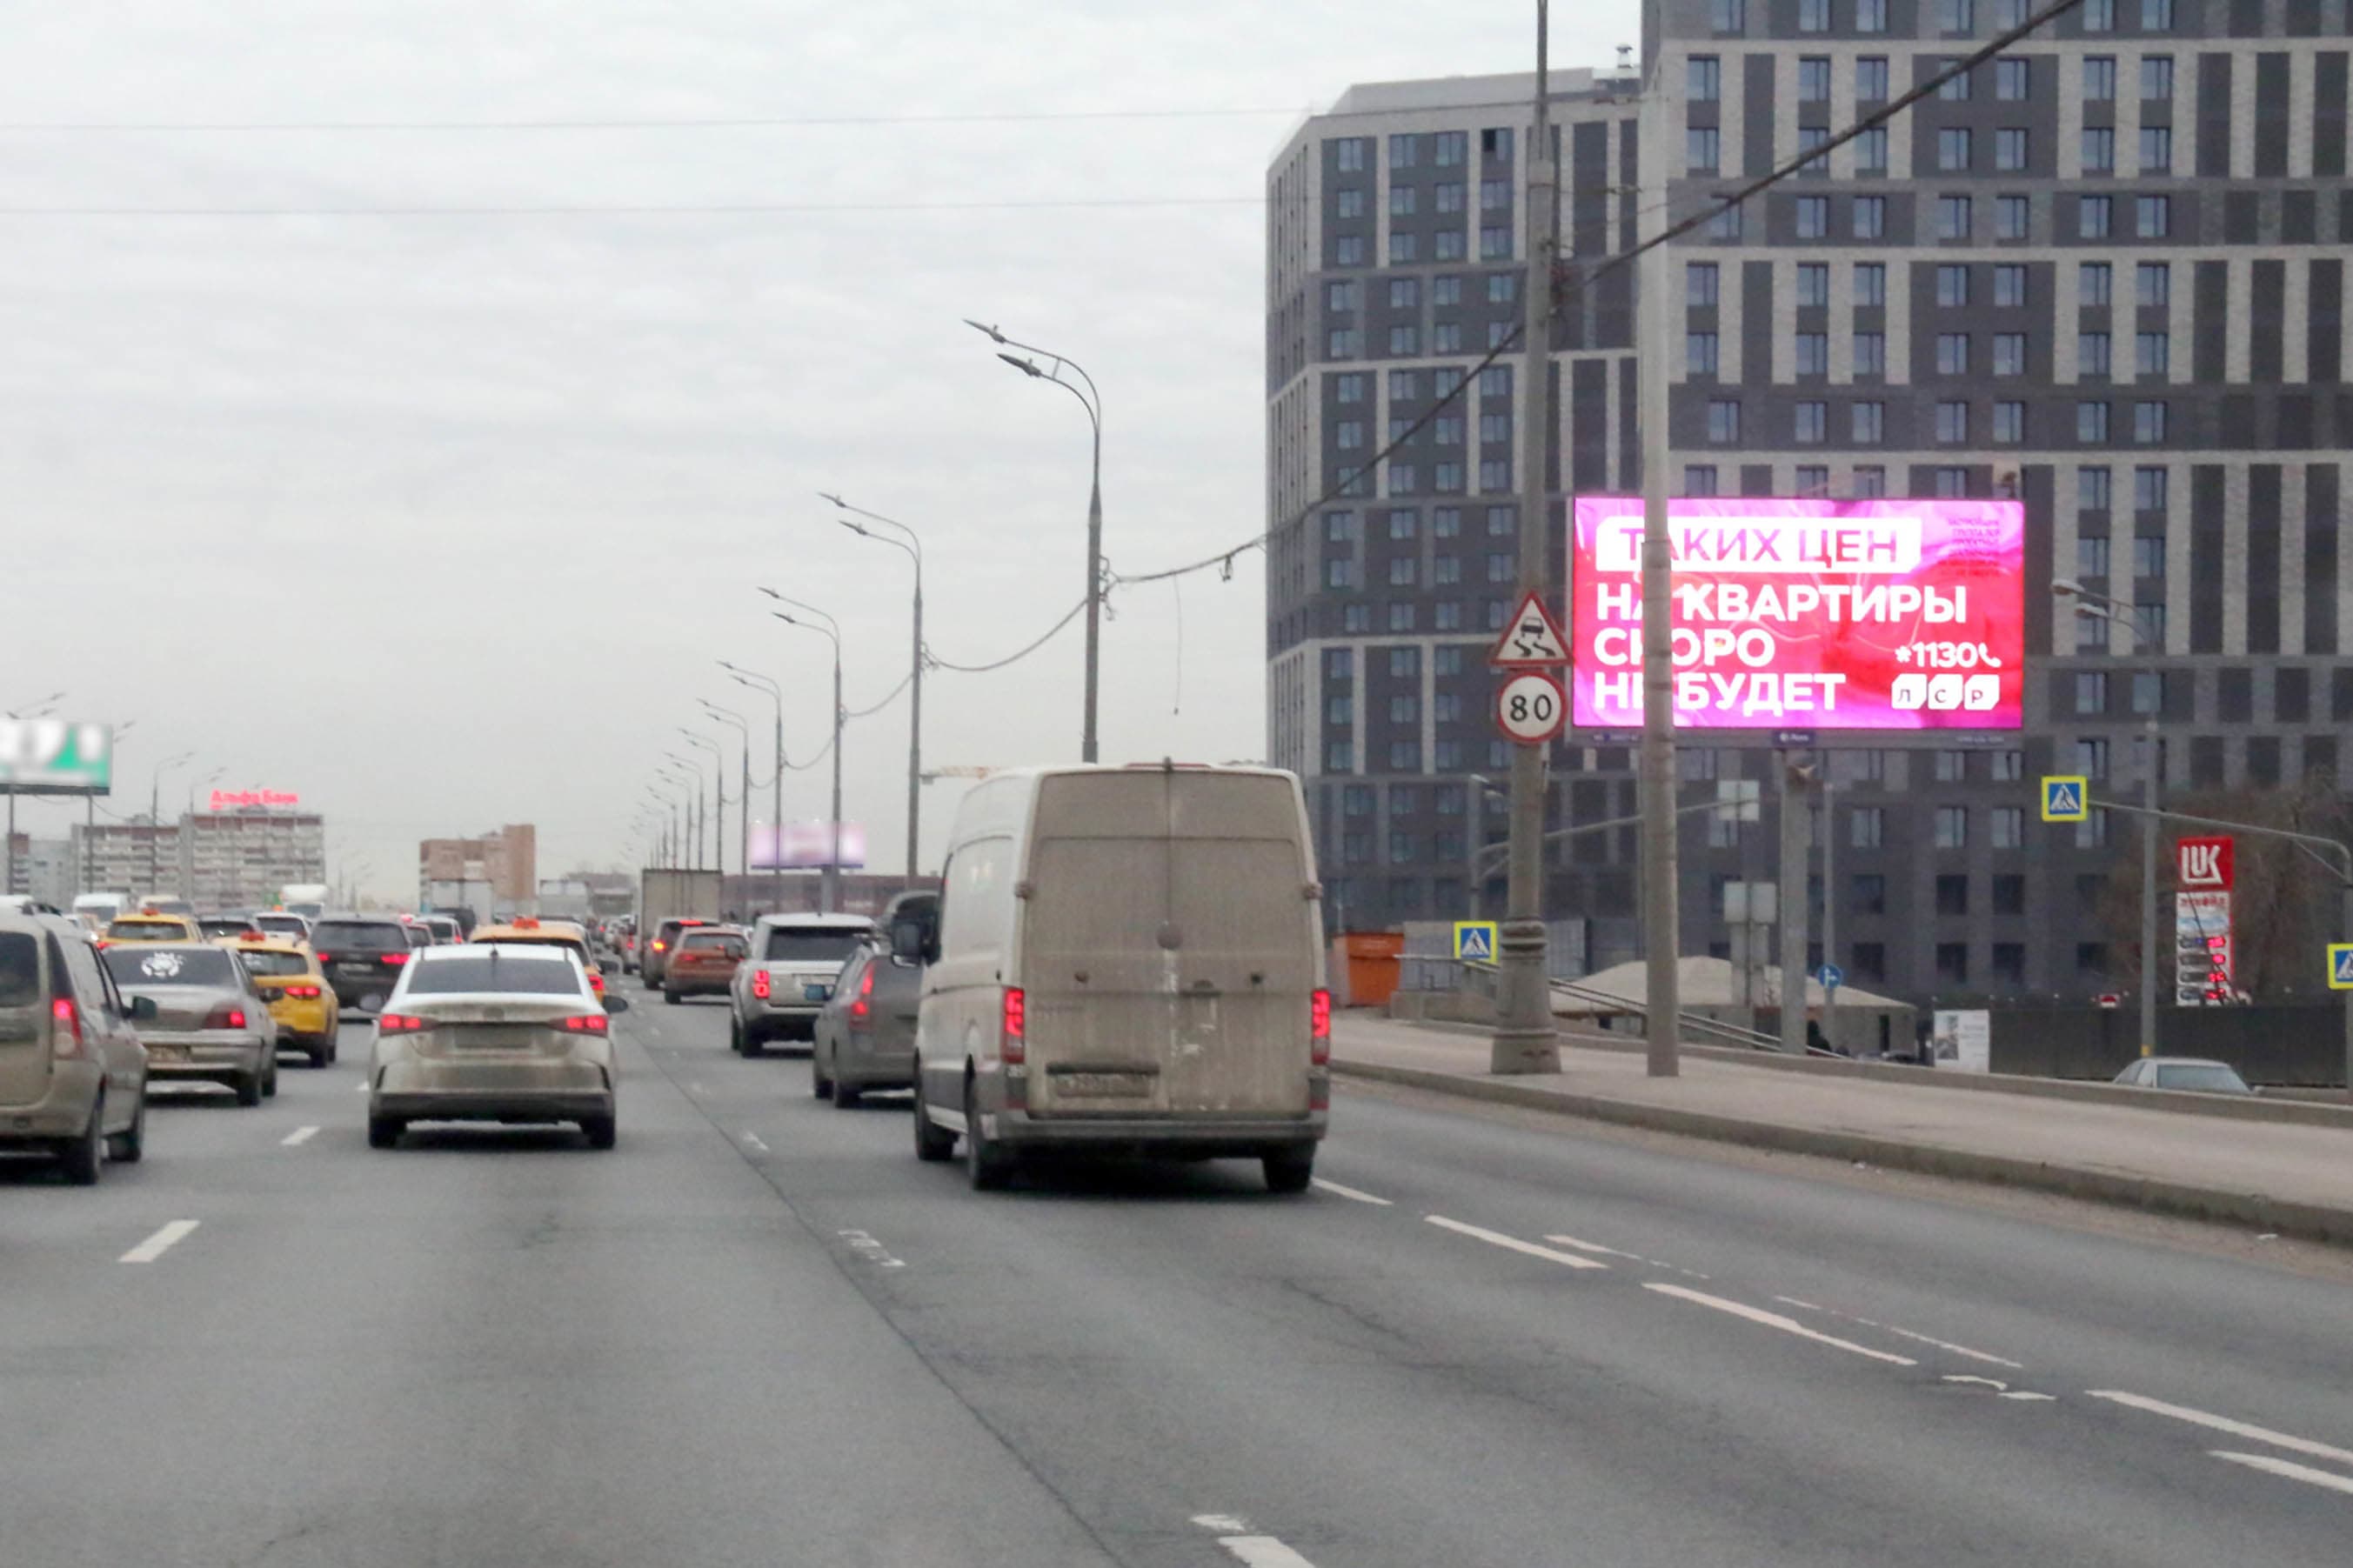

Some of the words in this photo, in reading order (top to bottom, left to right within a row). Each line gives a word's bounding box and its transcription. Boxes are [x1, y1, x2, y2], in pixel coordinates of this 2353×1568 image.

[1799, 530, 1896, 569] ЦЕН
[1597, 583, 1643, 620] Н
[1682, 584, 1966, 623] КВАРТИРЫ
[1510, 694, 1552, 722] 80
[1678, 672, 1846, 717] БУДЕТ
